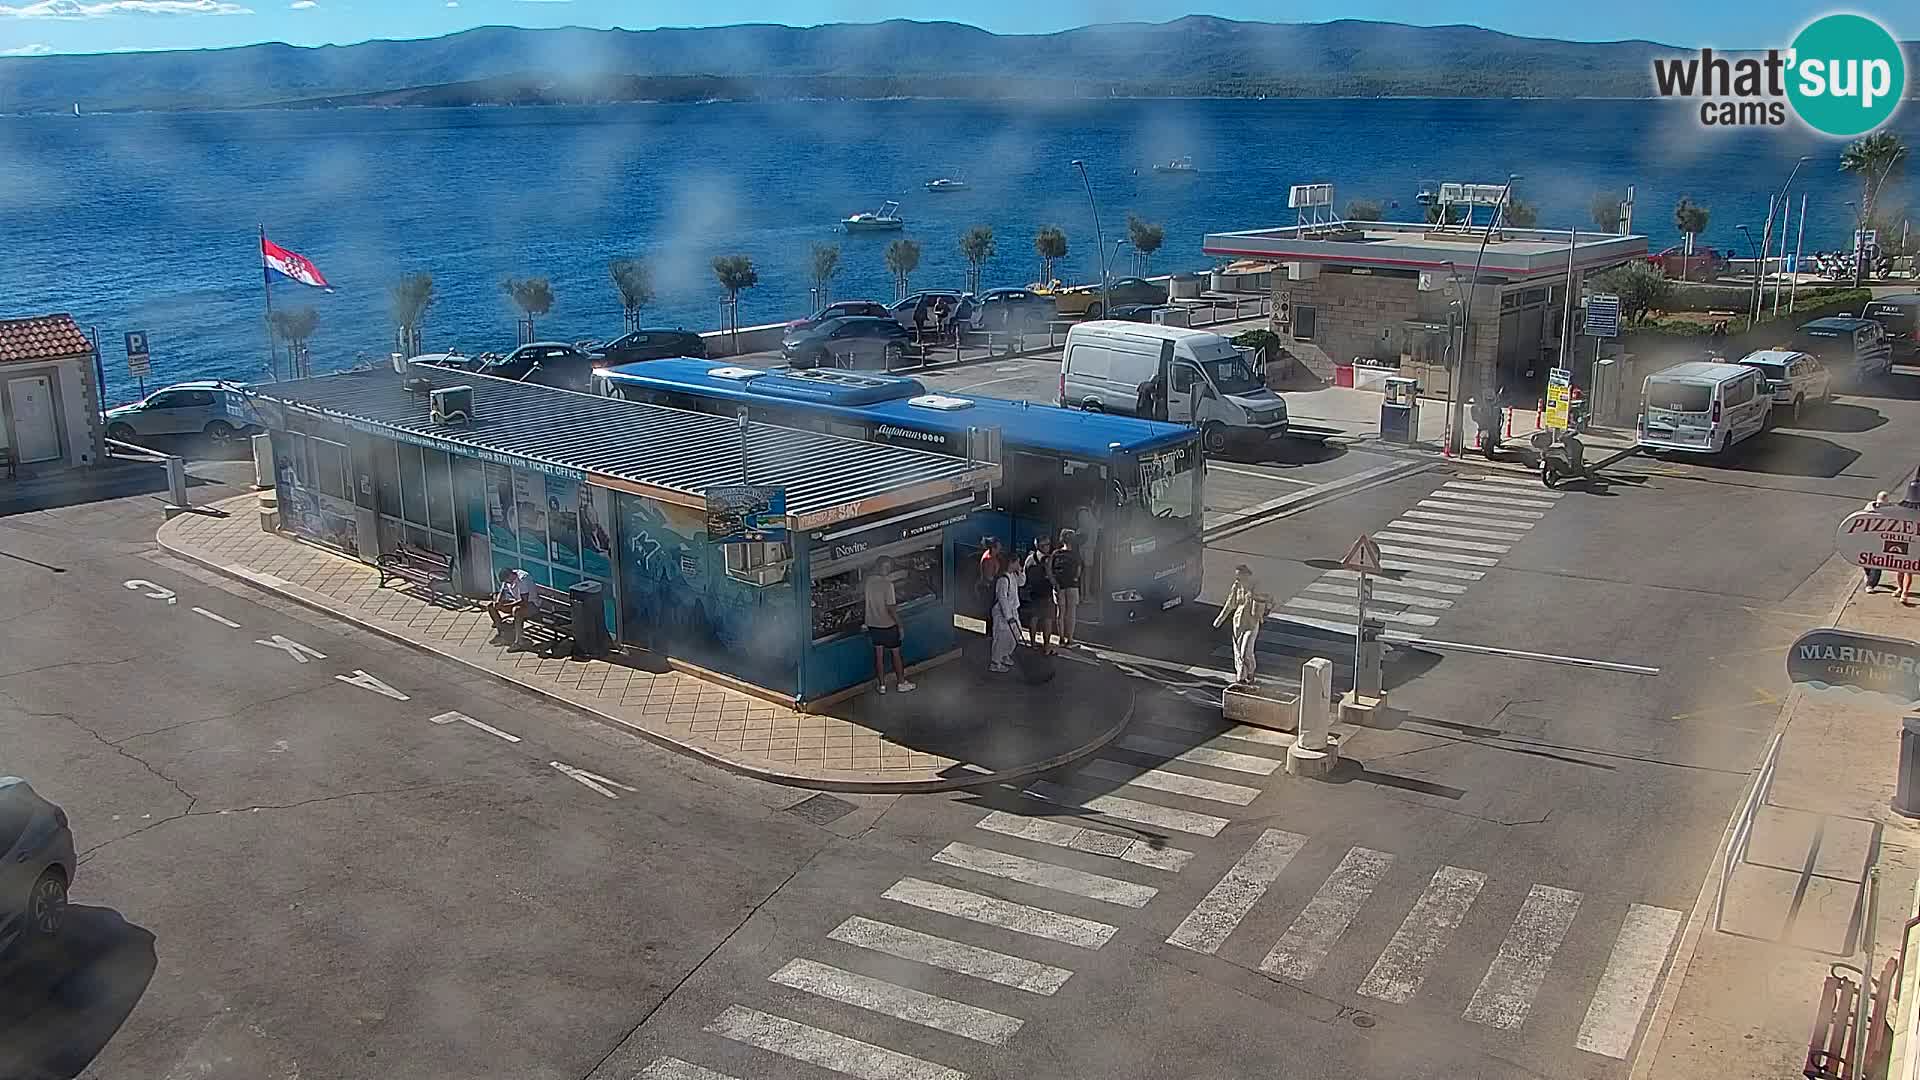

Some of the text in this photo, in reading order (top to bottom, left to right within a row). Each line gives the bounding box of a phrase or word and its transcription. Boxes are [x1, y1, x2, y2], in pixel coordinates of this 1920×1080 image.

[878, 424, 922, 440] Autotrans
[478, 450, 493, 461] BUS
[493, 453, 526, 467] STATION
[527, 461, 554, 474] TICKET
[555, 466, 582, 480] OFFICE
[1847, 518, 1920, 536] PIZZE
[1880, 533, 1916, 543] GRILL
